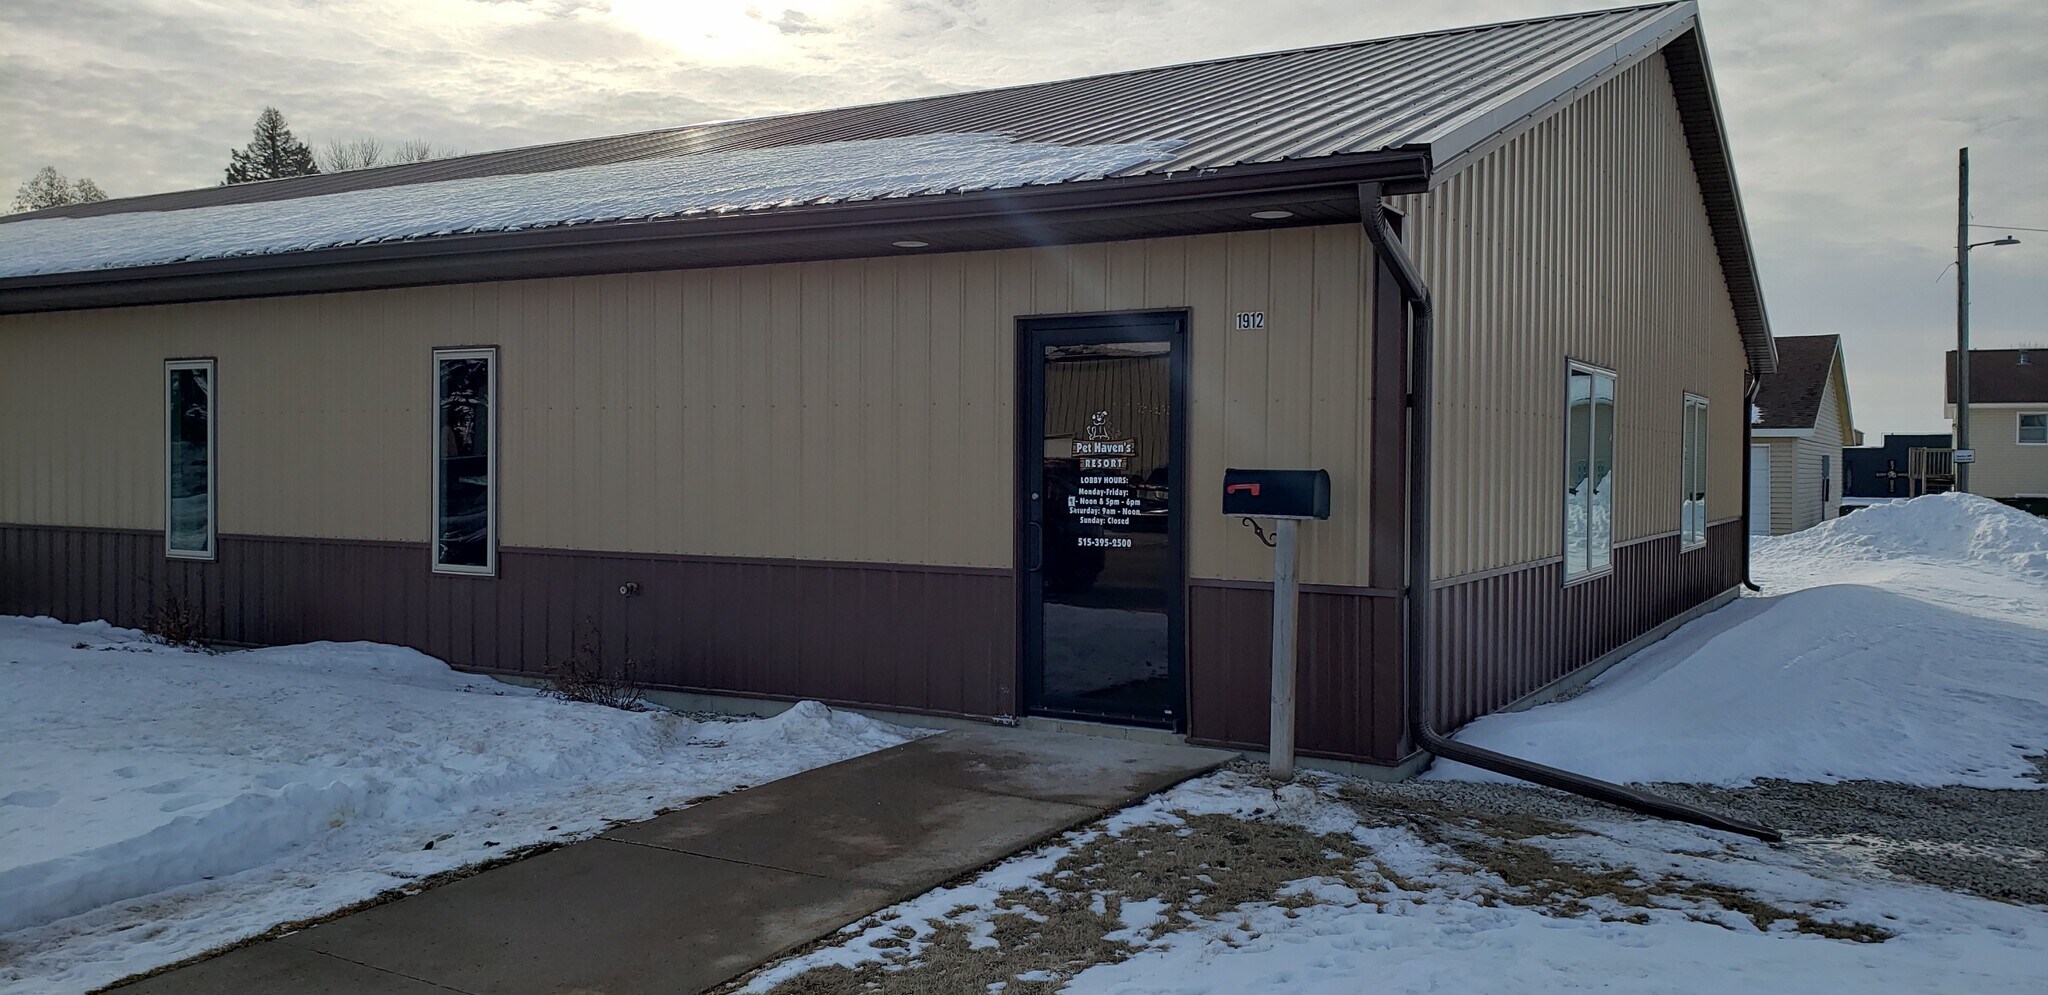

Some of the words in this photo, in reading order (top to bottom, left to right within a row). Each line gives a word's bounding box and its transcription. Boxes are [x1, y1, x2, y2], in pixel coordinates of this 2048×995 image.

[1237, 313, 1263, 328] 1912
[1076, 443, 1092, 453] Pet
[1094, 442, 1132, 453] Haven's
[1086, 459, 1122, 468] RESORT
[1103, 476, 1129, 484] HOURS:
[1079, 488, 1129, 497] Monday-Friday:
[1080, 497, 1098, 505] Noon
[1105, 498, 1120, 506] 5pm
[1126, 498, 1141, 507] 6pm
[1069, 507, 1100, 515] Saturday:
[1102, 507, 1116, 515] 9am
[1080, 516, 1105, 525] Sunday:
[1107, 517, 1130, 525] Closed
[1078, 537, 1132, 547] 515-395-2500
